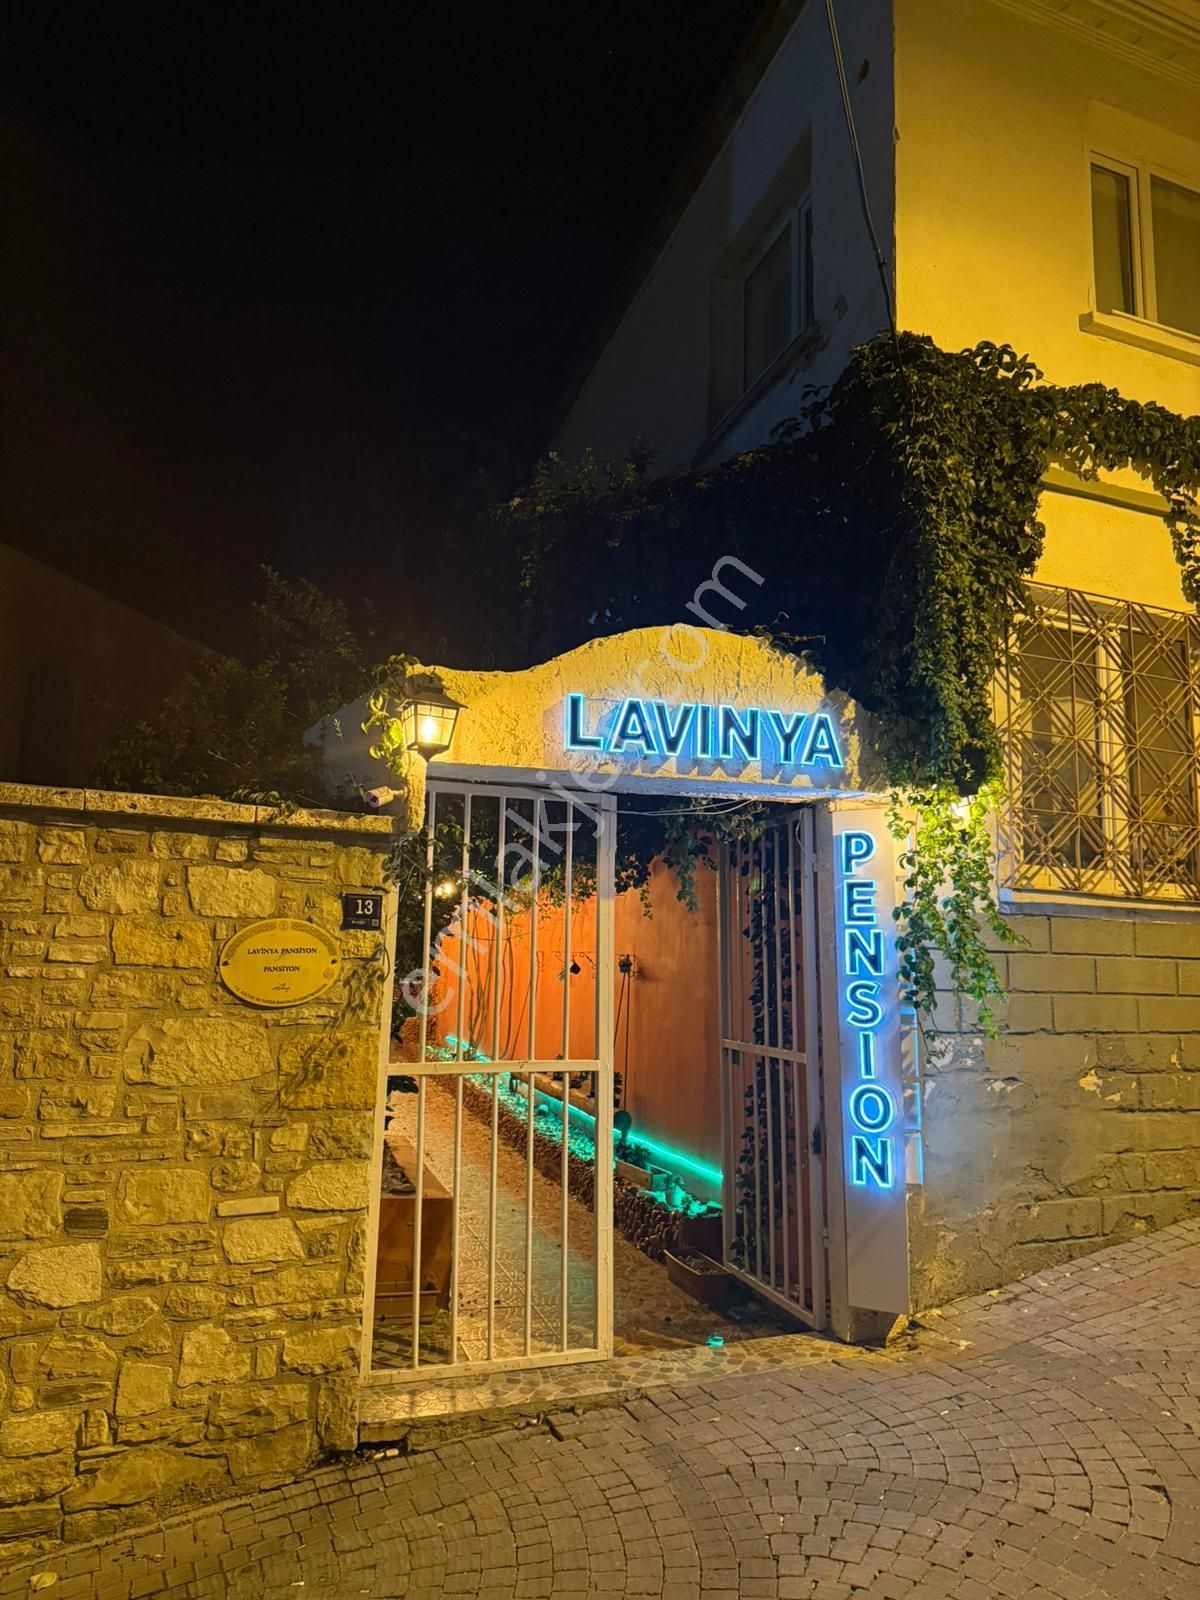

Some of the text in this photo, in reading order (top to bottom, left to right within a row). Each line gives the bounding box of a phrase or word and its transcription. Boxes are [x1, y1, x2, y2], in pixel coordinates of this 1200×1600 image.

[565, 692, 844, 769] LAVINYA
[356, 899, 374, 915] 13
[840, 829, 895, 1189] PENSION
